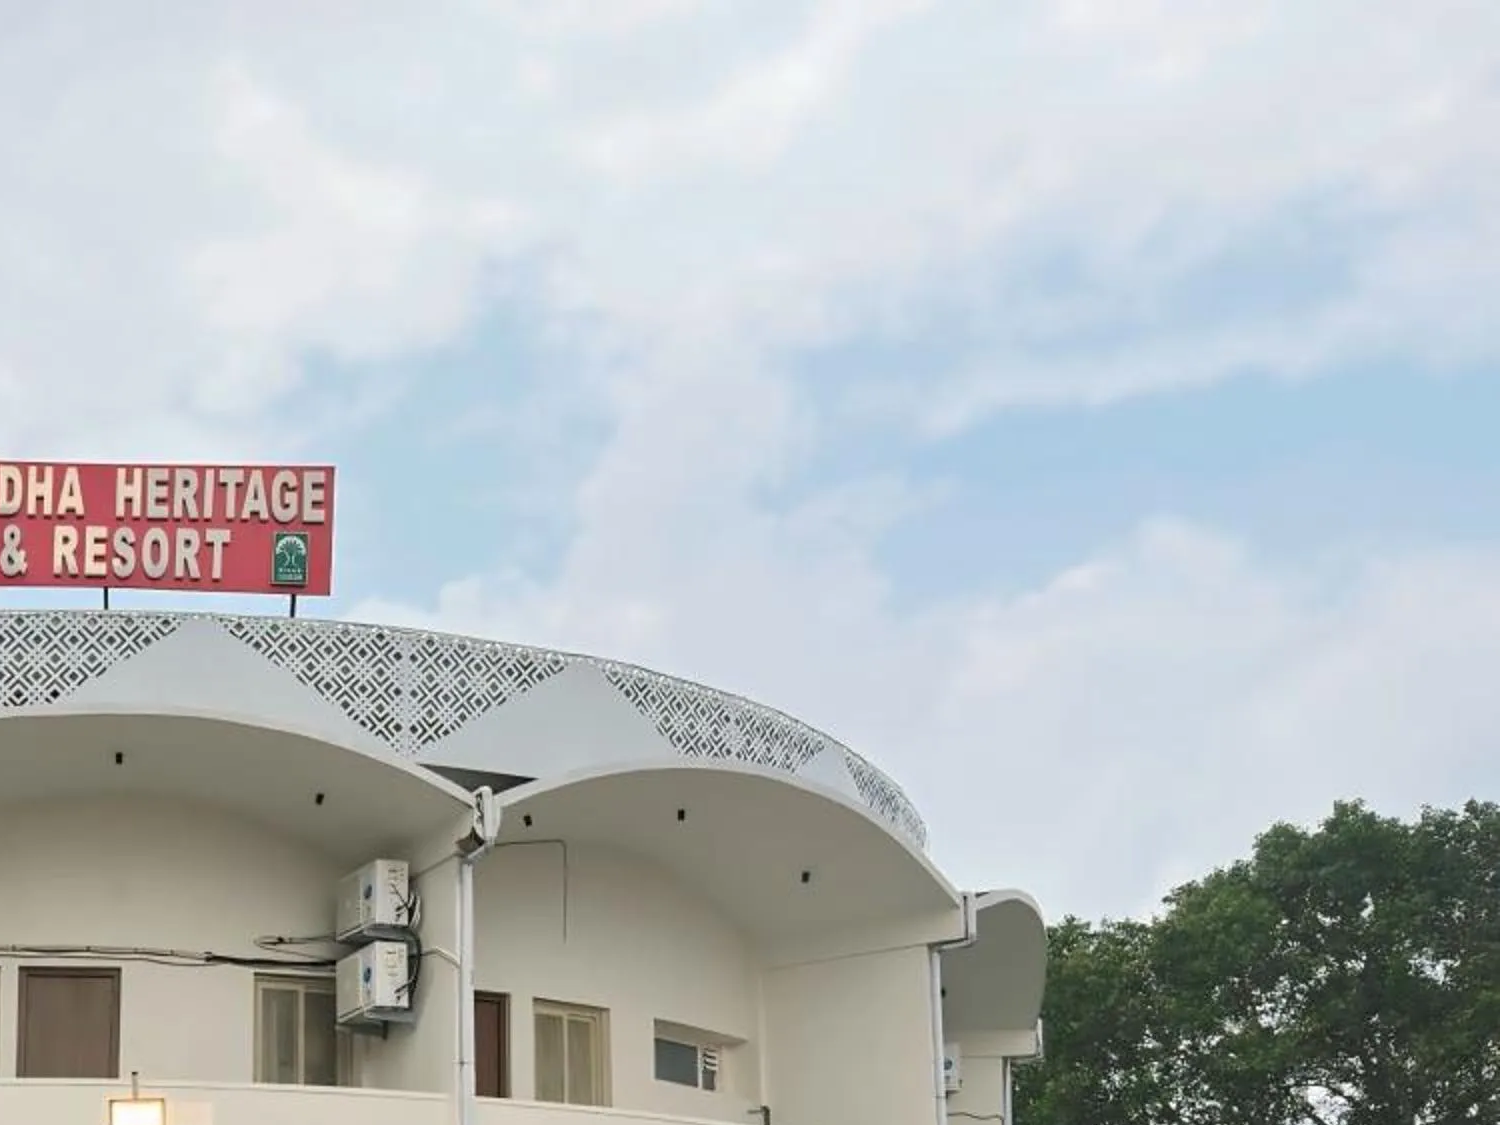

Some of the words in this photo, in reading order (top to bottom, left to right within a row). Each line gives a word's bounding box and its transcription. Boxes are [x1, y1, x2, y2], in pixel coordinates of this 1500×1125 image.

[115, 467, 325, 523] HERITAGE
[0, 524, 28, 577] &
[53, 525, 231, 580] RESORT
